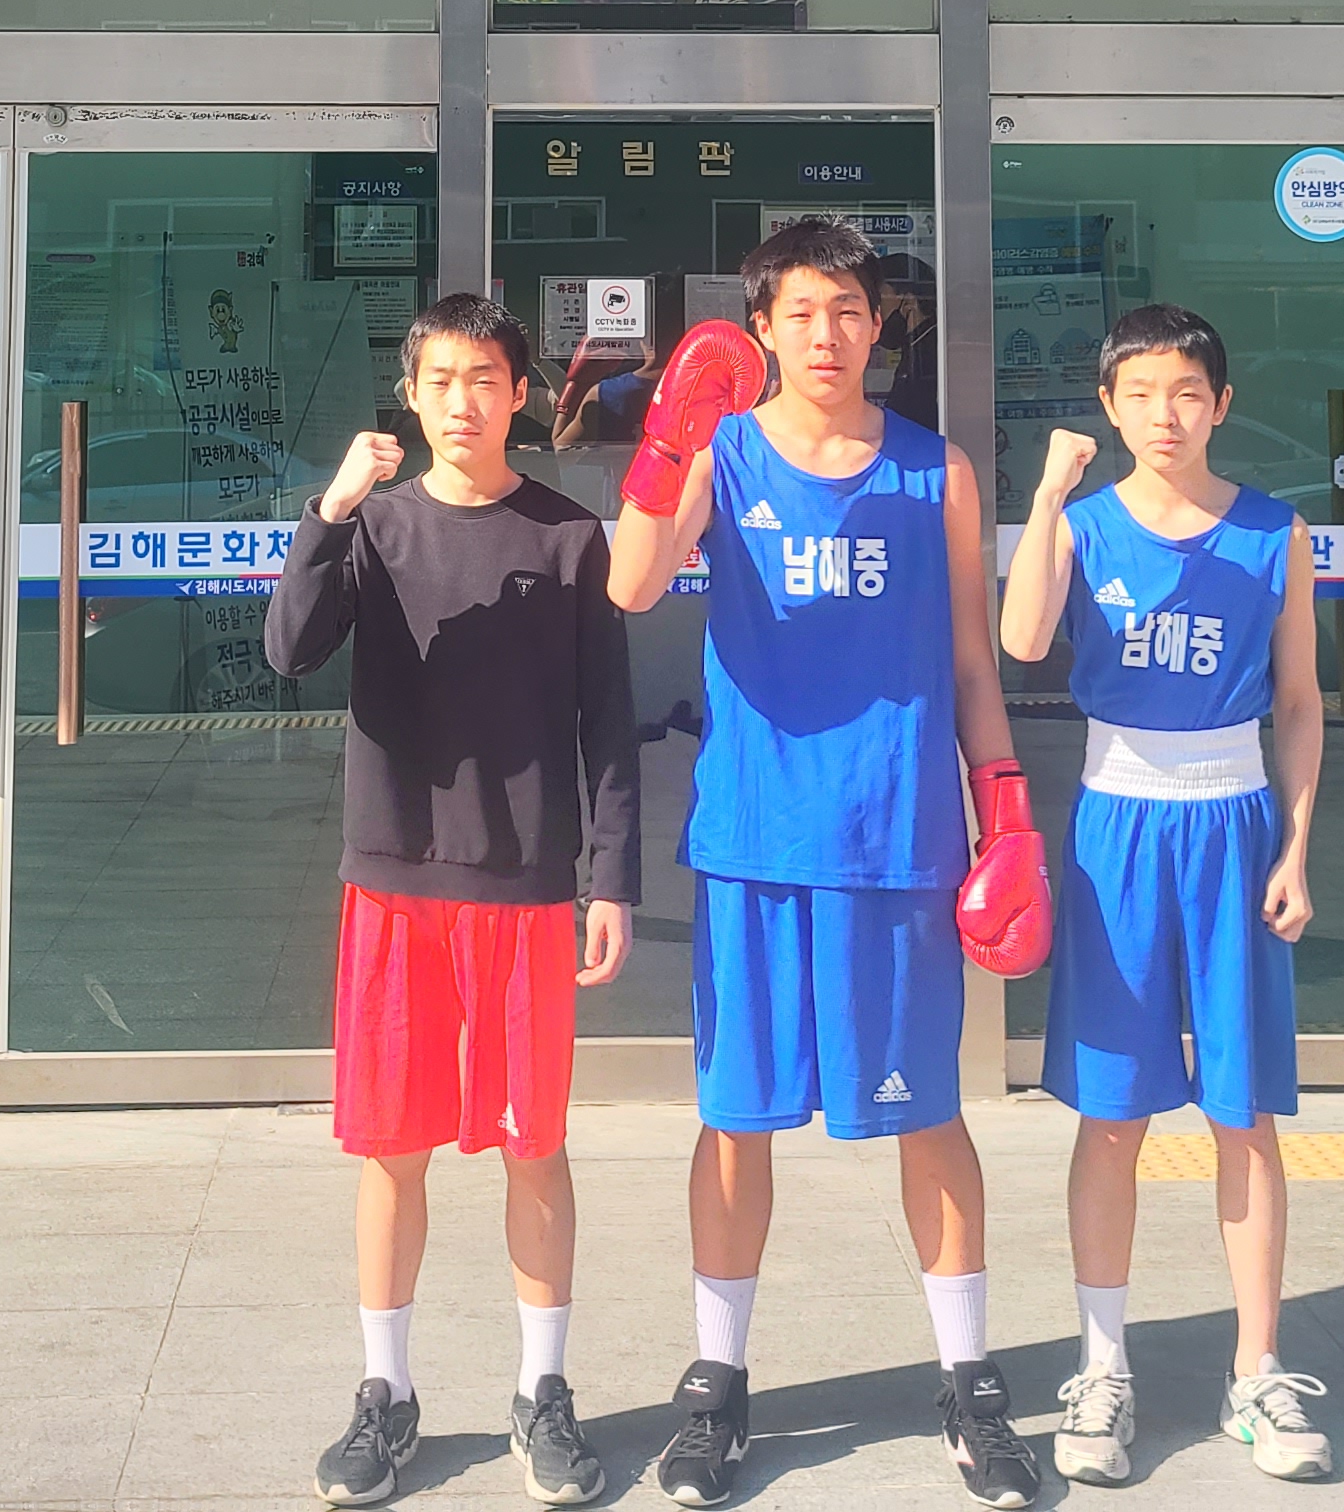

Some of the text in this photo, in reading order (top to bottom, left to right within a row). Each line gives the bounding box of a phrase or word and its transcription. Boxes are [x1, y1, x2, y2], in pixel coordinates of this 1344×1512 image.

[804, 166, 862, 181] 이용안내
[342, 181, 402, 196] 공지사항
[875, 217, 908, 231] 사용시간
[595, 318, 615, 326] CCTV
[185, 366, 281, 393] 모두가 사용하는
[188, 402, 285, 436] 공공시설이므로
[191, 440, 284, 468] 깨끗하게 사용하여
[218, 474, 260, 502] 모두가
[740, 516, 782, 530] adidas
[782, 536, 888, 598] 남해중
[1093, 593, 1136, 608] adidas
[205, 605, 241, 632] 이용할
[244, 603, 256, 626] 수
[217, 639, 252, 675] 적극
[1121, 611, 1224, 676] 남해중
[873, 1091, 912, 1103] adidas
